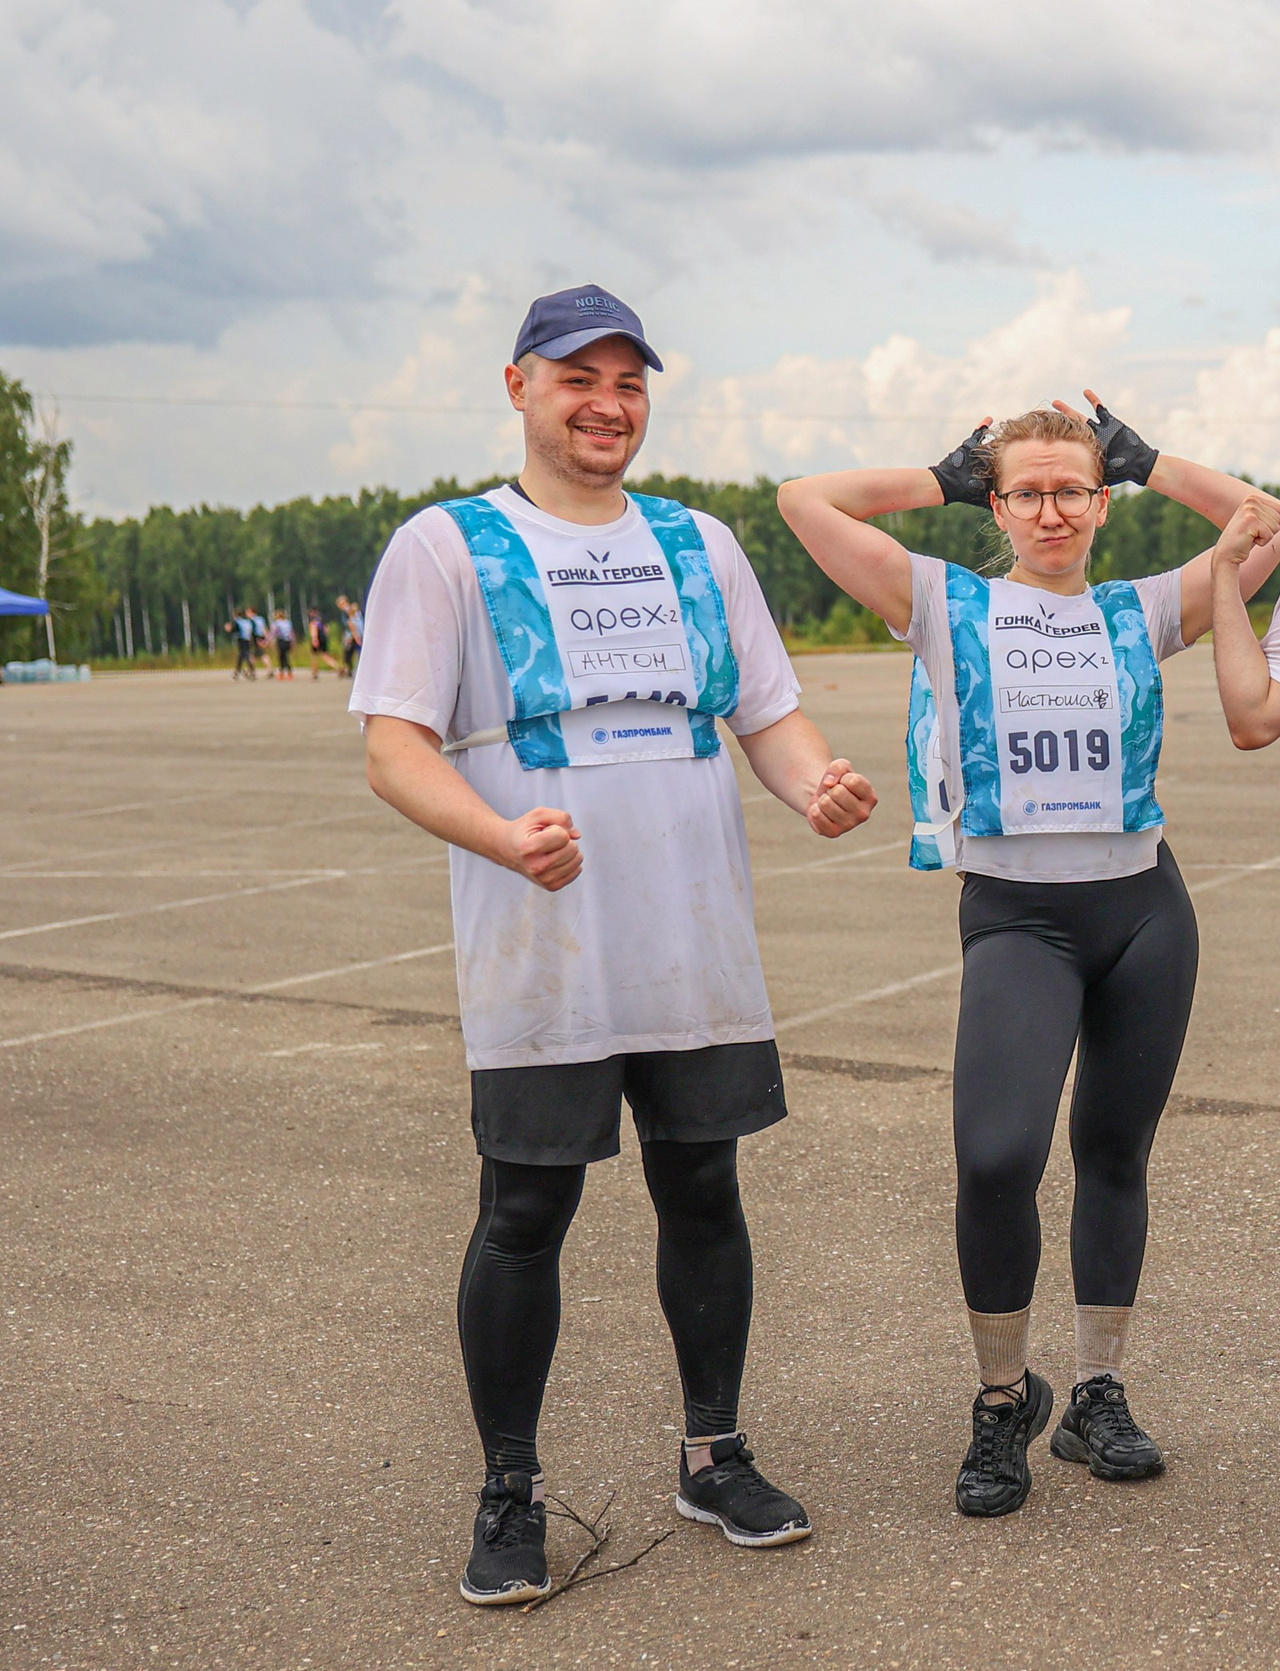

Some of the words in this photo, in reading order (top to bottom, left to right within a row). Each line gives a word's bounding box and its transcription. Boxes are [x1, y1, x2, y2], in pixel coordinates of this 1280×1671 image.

[575, 296, 620, 312] NOETIC
[547, 568, 600, 582] ГОНКА
[603, 565, 663, 582] ГЕРОЕВ
[571, 604, 667, 636] apex
[995, 616, 1042, 631] ГОНКА
[1045, 622, 1101, 636] ГЕРОЕВ
[1006, 649, 1098, 674] apex
[612, 727, 673, 739] ГАЗПРОМБАНК
[1008, 728, 1110, 774] 5019
[1041, 800, 1102, 812] ГАЗПРОМБАНК
